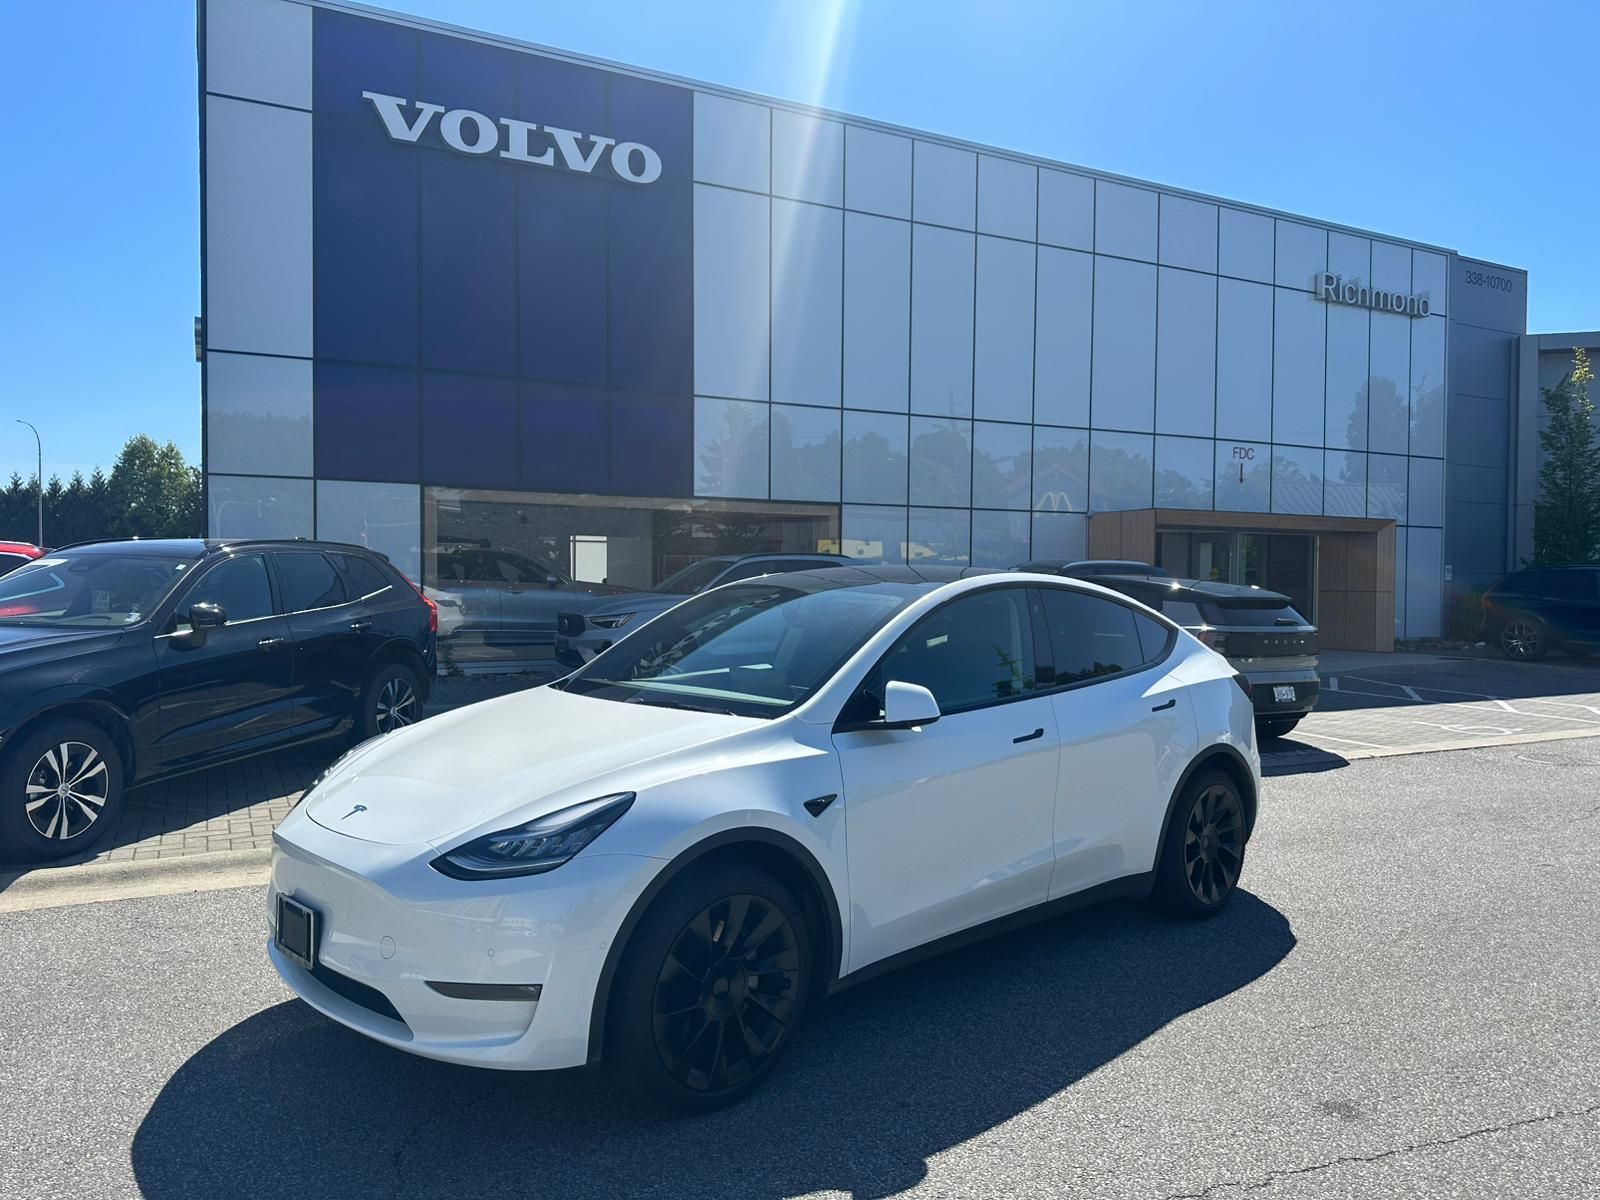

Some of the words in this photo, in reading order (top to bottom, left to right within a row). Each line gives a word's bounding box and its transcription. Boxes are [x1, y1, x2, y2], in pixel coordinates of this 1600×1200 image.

[362, 90, 662, 183] VOLVO
[1320, 271, 1431, 317] Richmond
[1465, 270, 1512, 293] 338-10700
[1232, 446, 1255, 460] FDC
